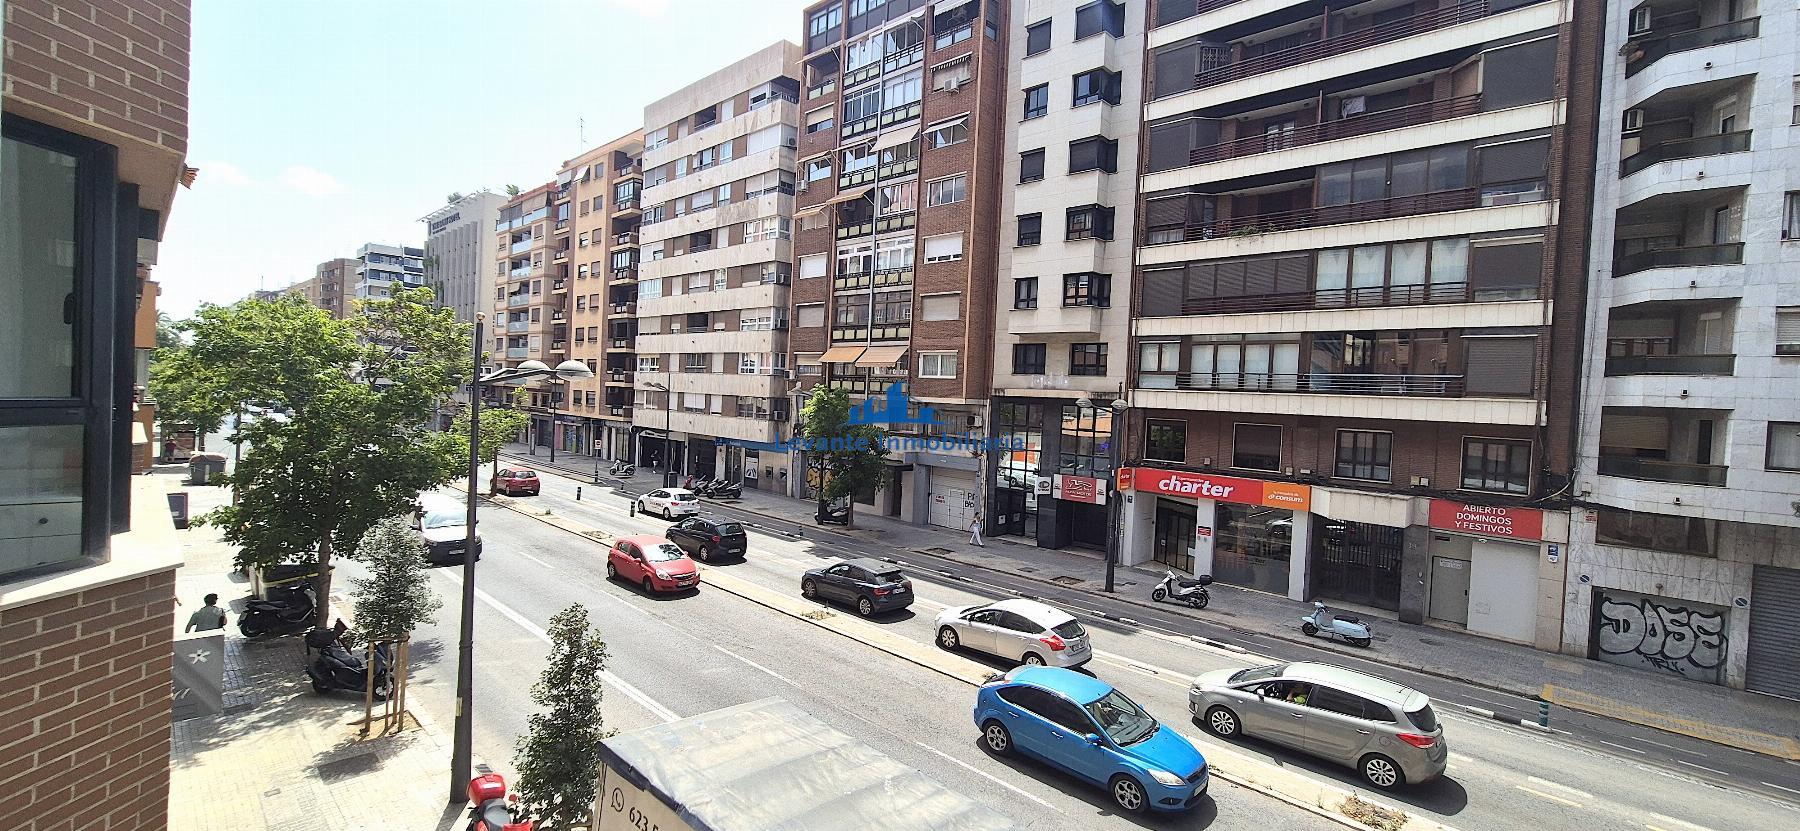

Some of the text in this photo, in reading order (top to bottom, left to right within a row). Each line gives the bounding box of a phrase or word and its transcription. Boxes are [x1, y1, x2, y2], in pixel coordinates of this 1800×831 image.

[1158, 475, 1234, 498] charter
[1463, 504, 1506, 516] ABIERTO
[1456, 512, 1512, 526] DOMINGOS
[1454, 520, 1513, 535] Y FESTIVOS
